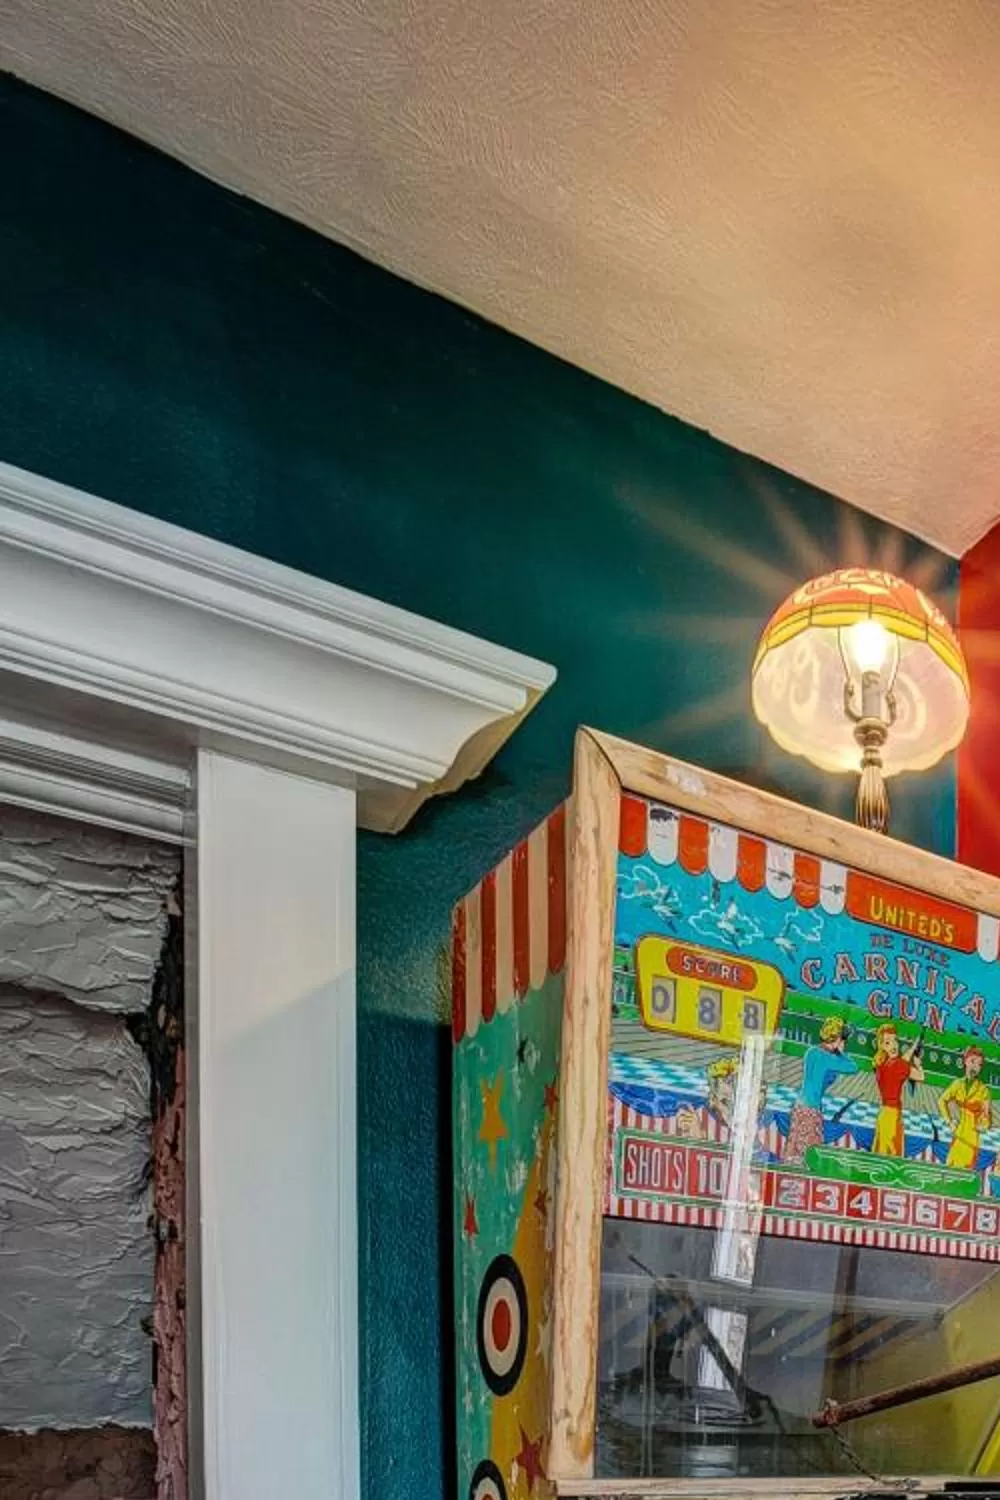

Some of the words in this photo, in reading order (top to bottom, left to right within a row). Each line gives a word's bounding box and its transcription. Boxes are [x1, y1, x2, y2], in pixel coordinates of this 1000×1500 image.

[869, 895, 955, 944] UNITED'S
[866, 987, 949, 1034] GUN
[626, 1143, 684, 1190] SHOTS
[695, 1153, 729, 1195] 10
[815, 1183, 841, 1212] 3
[849, 1189, 873, 1216] 4
[881, 1193, 907, 1221] 5
[914, 1199, 939, 1225] 6
[945, 1204, 970, 1228] 7
[975, 1208, 998, 1233] 8
